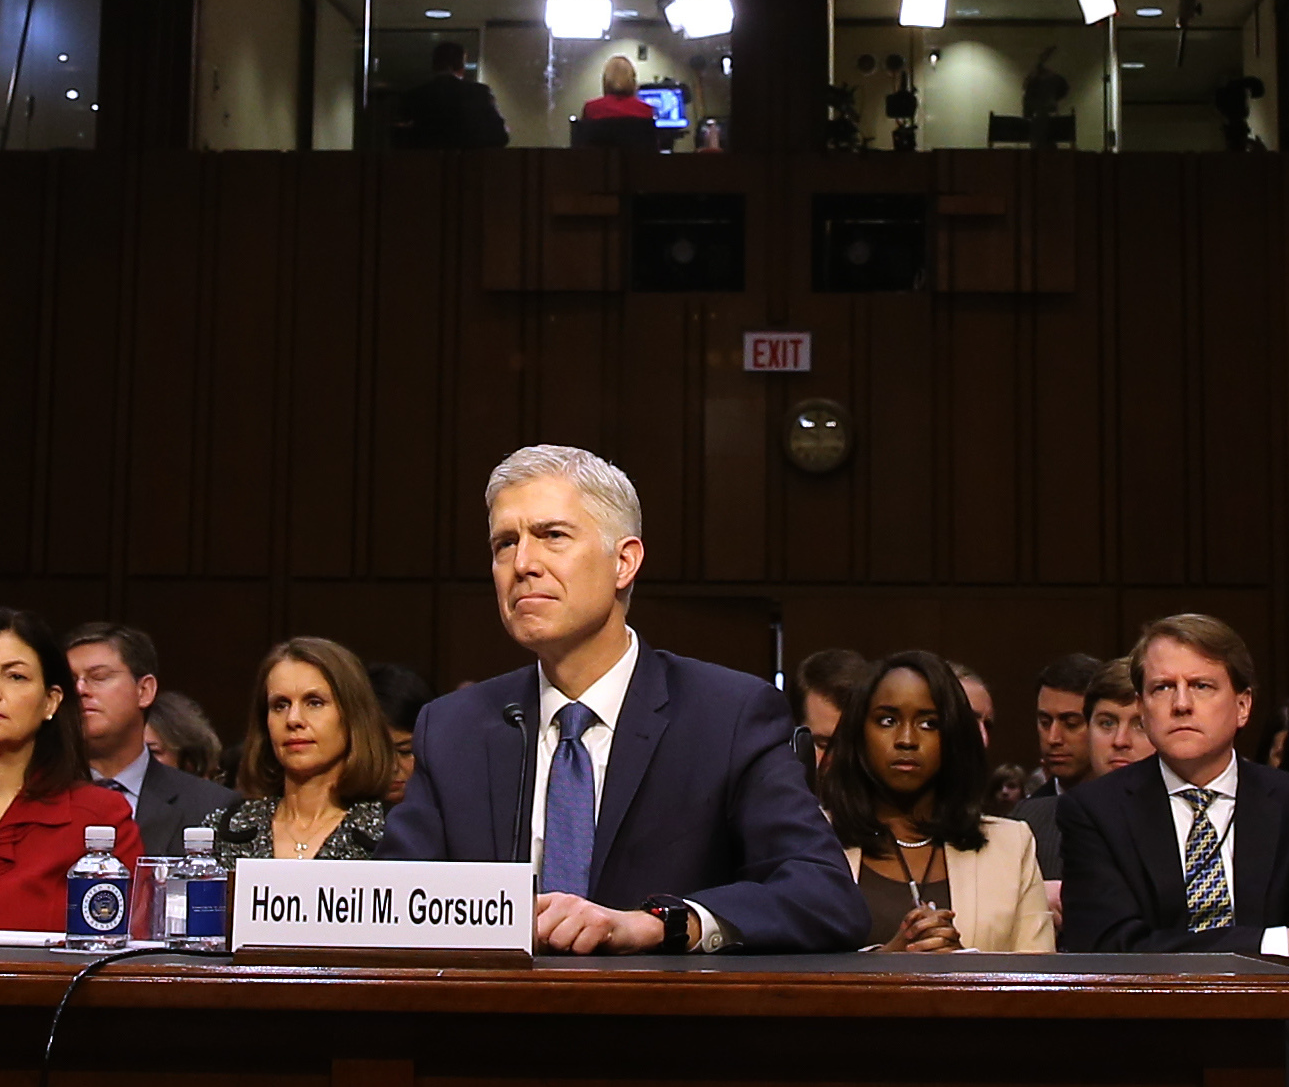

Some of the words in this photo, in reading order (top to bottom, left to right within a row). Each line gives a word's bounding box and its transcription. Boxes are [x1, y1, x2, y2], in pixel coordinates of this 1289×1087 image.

[753, 339, 803, 368] EXIT
[252, 885, 307, 922] Hon.
[317, 887, 363, 923] Neil
[372, 888, 399, 924] M.
[408, 889, 514, 926] Gorsuch
